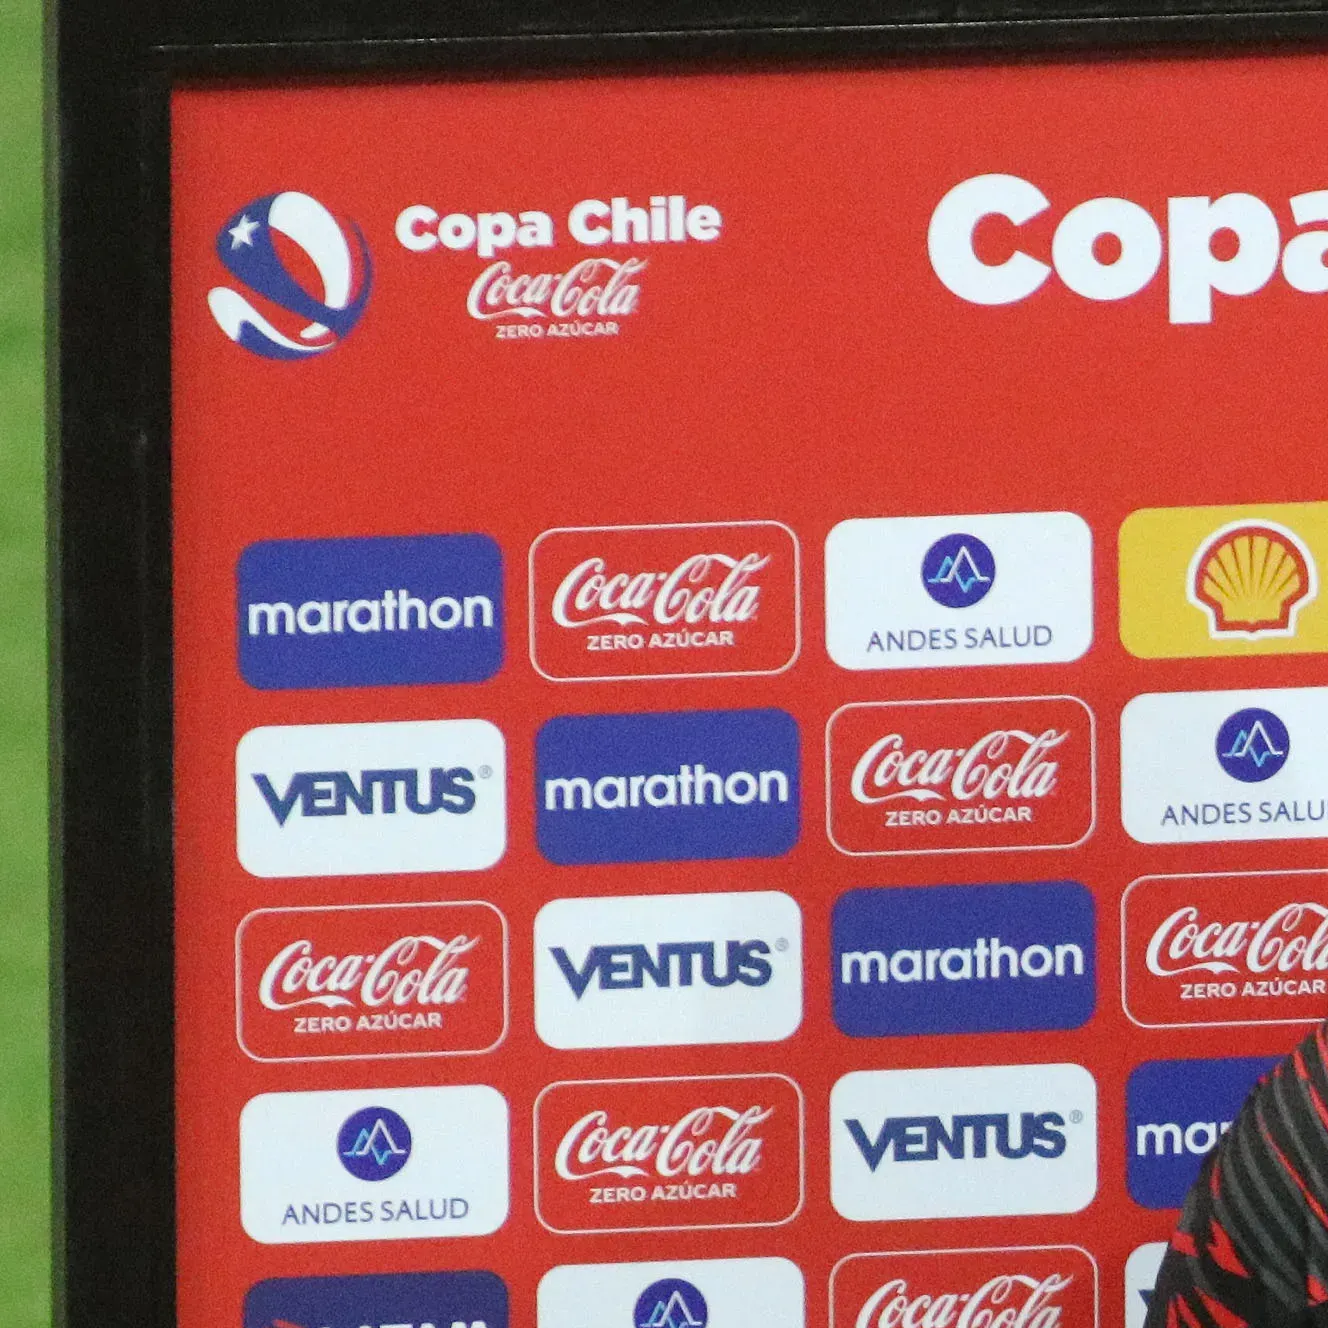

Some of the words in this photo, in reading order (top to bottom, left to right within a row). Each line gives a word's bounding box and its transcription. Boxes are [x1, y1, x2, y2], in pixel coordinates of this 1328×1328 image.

[395, 205, 553, 258] Copa
[569, 196, 722, 245] Chile
[467, 257, 647, 320] Coca-Cola
[496, 323, 543, 339] ZERO
[547, 318, 619, 337] AZÚCAR
[249, 589, 493, 635] marathon
[552, 553, 770, 628] Coca-Cola
[587, 634, 645, 651] ZERO
[648, 628, 734, 648] AZÚCAR
[867, 628, 958, 652] ANDES
[965, 625, 1052, 649] SALUD
[546, 764, 788, 810] marathon
[851, 729, 1068, 804] Coca-Cola
[253, 767, 476, 826] VENTUS
[885, 810, 942, 827] ZERO
[946, 804, 1032, 824] AZÚCAR
[1161, 802, 1252, 825] ANDES
[259, 935, 479, 1011] Coca-Cola
[550, 940, 772, 999] VENTUS
[842, 938, 1083, 983] marathon
[1180, 982, 1237, 1000] ZERO
[1241, 977, 1326, 996] AZÚCAR
[294, 1016, 352, 1033] ZERO
[356, 1011, 442, 1031] AZÚCAR
[555, 1106, 773, 1181] Coca-Cola
[845, 1112, 1066, 1172] VENTUS
[282, 1201, 374, 1225] ANDES
[381, 1197, 469, 1222] SALUD
[590, 1186, 647, 1204] ZERO
[651, 1181, 736, 1200] AZÚCAR
